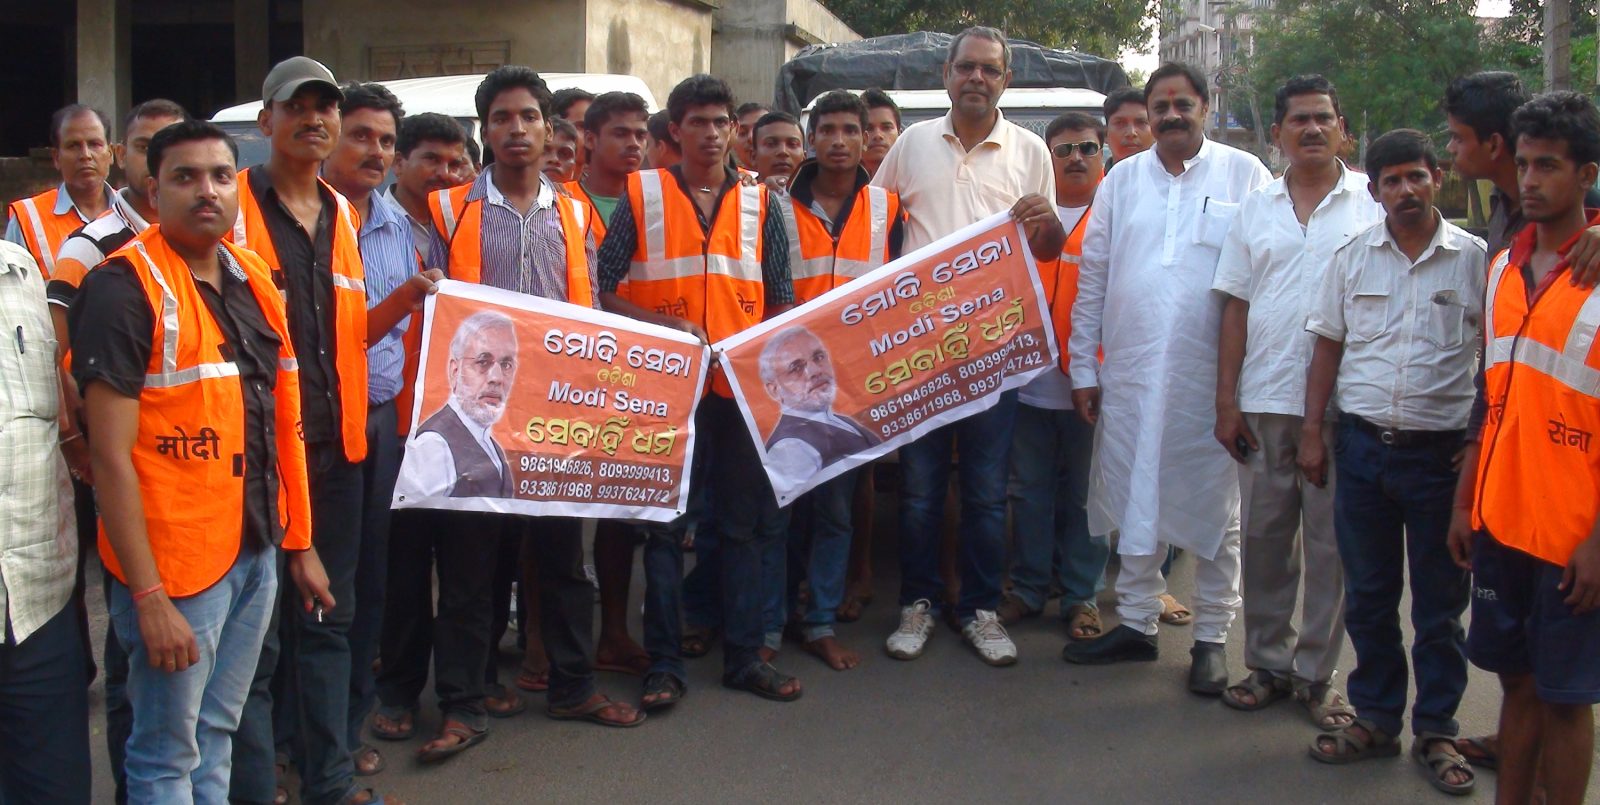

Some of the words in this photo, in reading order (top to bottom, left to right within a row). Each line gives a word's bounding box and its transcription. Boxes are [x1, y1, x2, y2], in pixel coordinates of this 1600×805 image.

[840, 271, 921, 326] ମୋଦି
[932, 236, 1013, 284] ସେନା
[869, 313, 935, 357] Modi
[939, 287, 1005, 324] Sena
[544, 329, 618, 363] ମୋଦି
[627, 345, 692, 377] ସେନା
[548, 381, 607, 408] Modi
[613, 391, 668, 417] Sena
[870, 372, 956, 422] 9861946826,
[881, 389, 967, 437] 9338611968,
[968, 351, 1043, 395] 99374742
[155, 425, 221, 460] मोदी
[1548, 412, 1592, 453] सेना
[519, 479, 593, 500] 9338611968,
[597, 484, 671, 503] 9937624742
[520, 456, 594, 478] 9861946826,
[598, 462, 674, 486] 8093999413,
